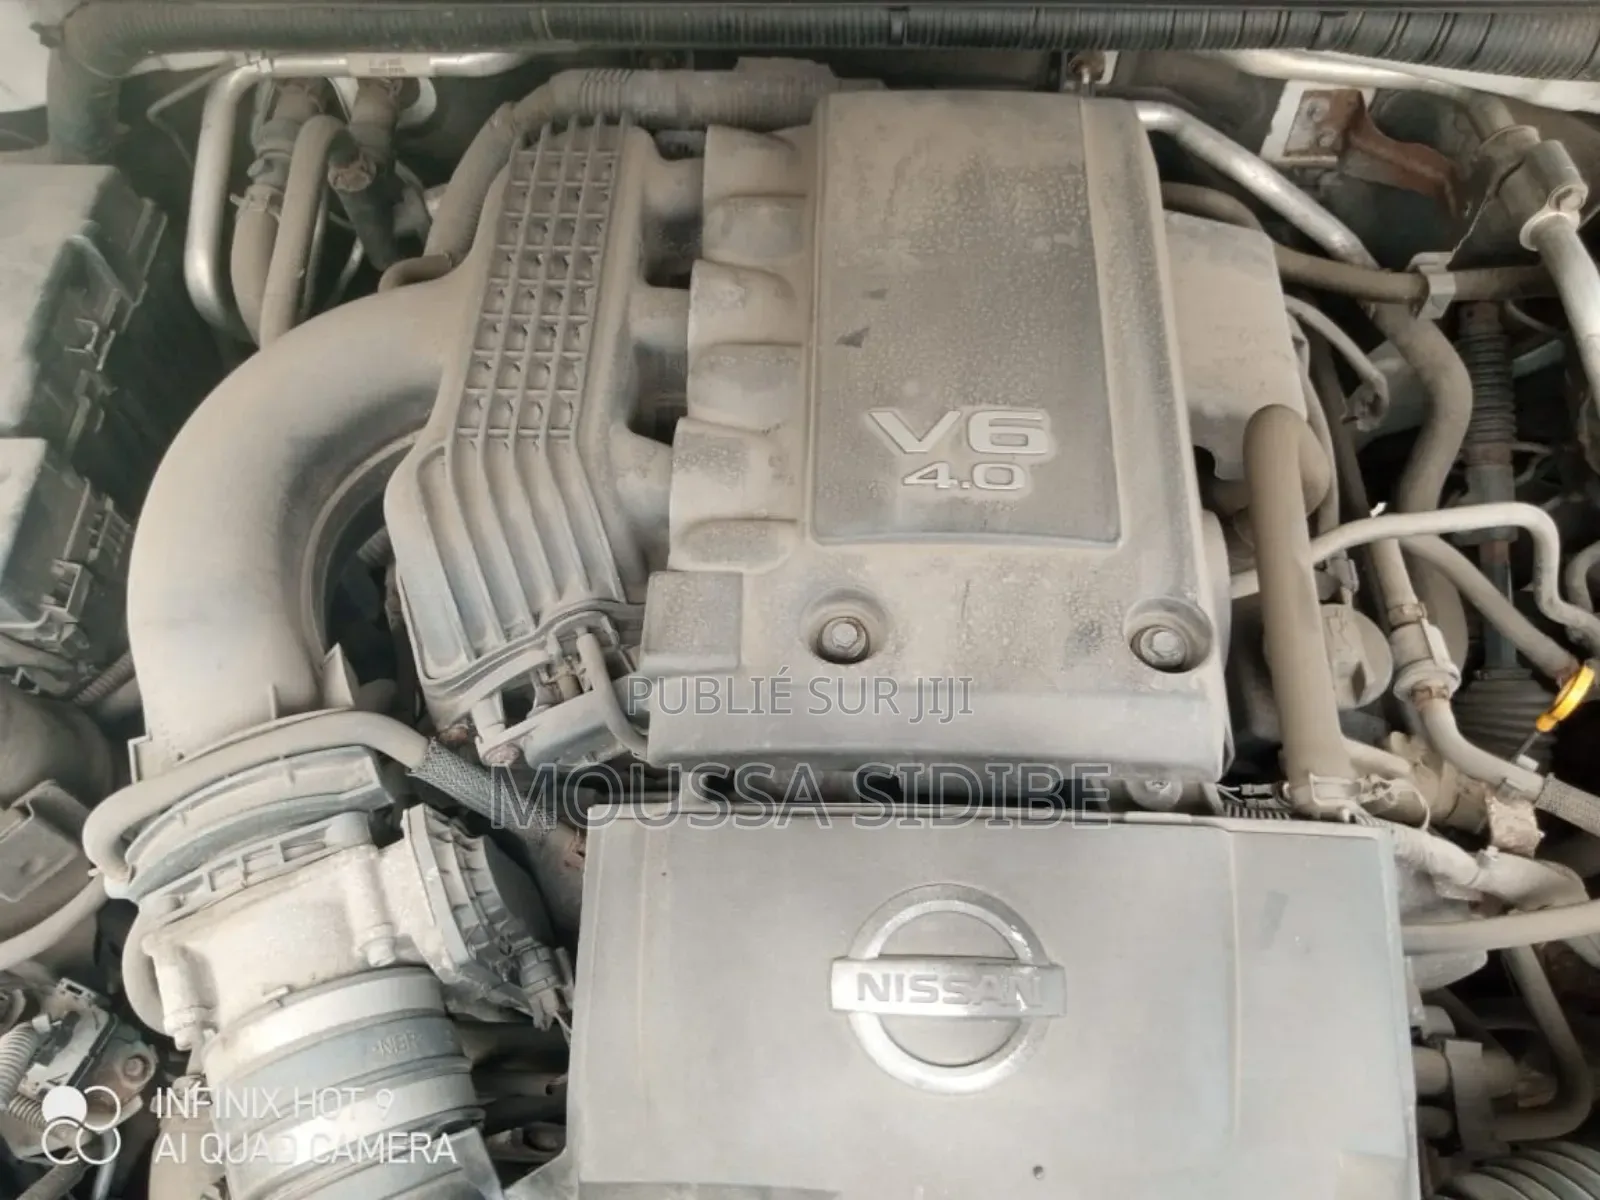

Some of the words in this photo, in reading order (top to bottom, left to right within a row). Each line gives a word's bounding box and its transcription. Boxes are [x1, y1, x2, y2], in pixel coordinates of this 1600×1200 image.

[868, 411, 1049, 455] V6
[902, 461, 1026, 490] 4.0
[857, 972, 1043, 1007] NISSAN
